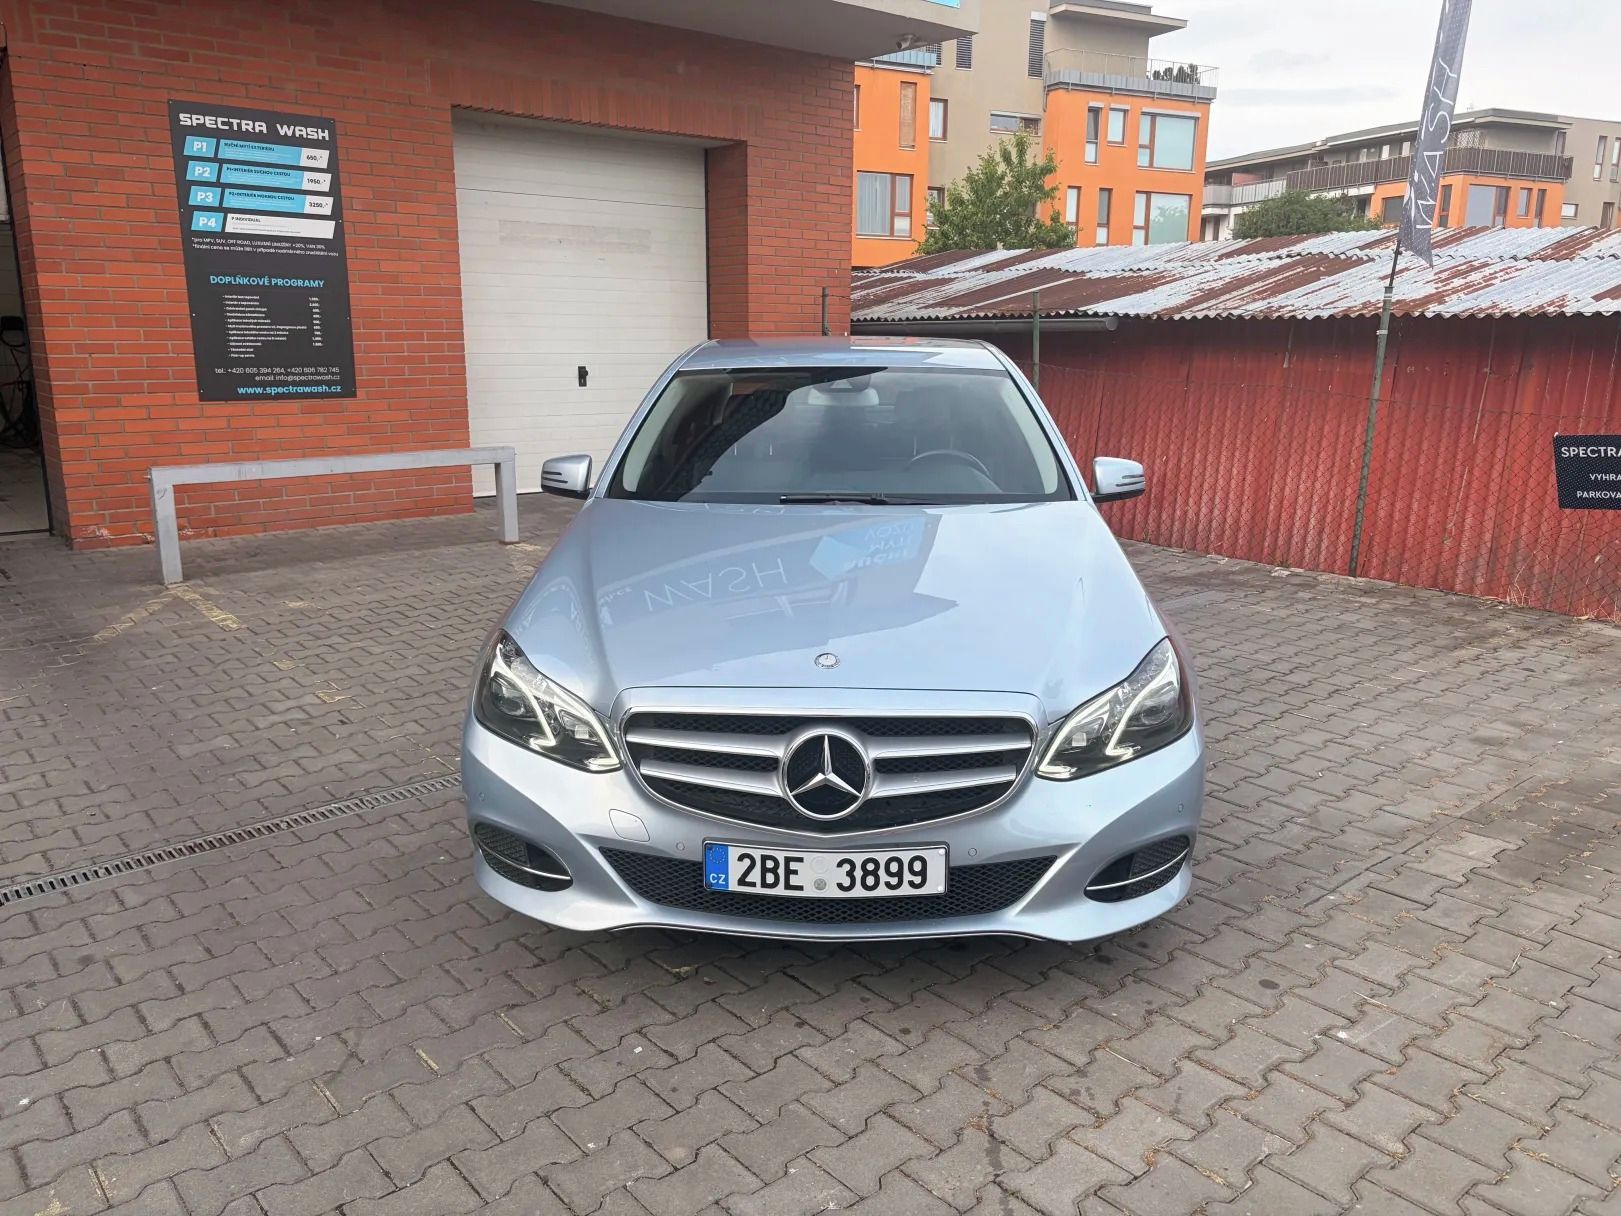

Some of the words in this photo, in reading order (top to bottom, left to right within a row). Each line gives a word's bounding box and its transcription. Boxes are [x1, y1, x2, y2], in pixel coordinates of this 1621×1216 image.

[179, 113, 267, 133] SPECTRA
[276, 124, 329, 140] WASH
[193, 142, 207, 152] P1
[1416, 57, 1457, 229] WASH
[195, 166, 211, 177] P2
[197, 191, 213, 203] P3
[199, 216, 216, 228] P4
[209, 274, 270, 286] DOPLŇKOVÉ
[271, 277, 325, 288] PROGRAMY
[237, 384, 342, 396] www.spectrawash.cz
[1561, 446, 1621, 458] SPECTR
[736, 852, 804, 891] 2BE
[836, 855, 928, 892] 3899
[709, 873, 726, 884] CZ
